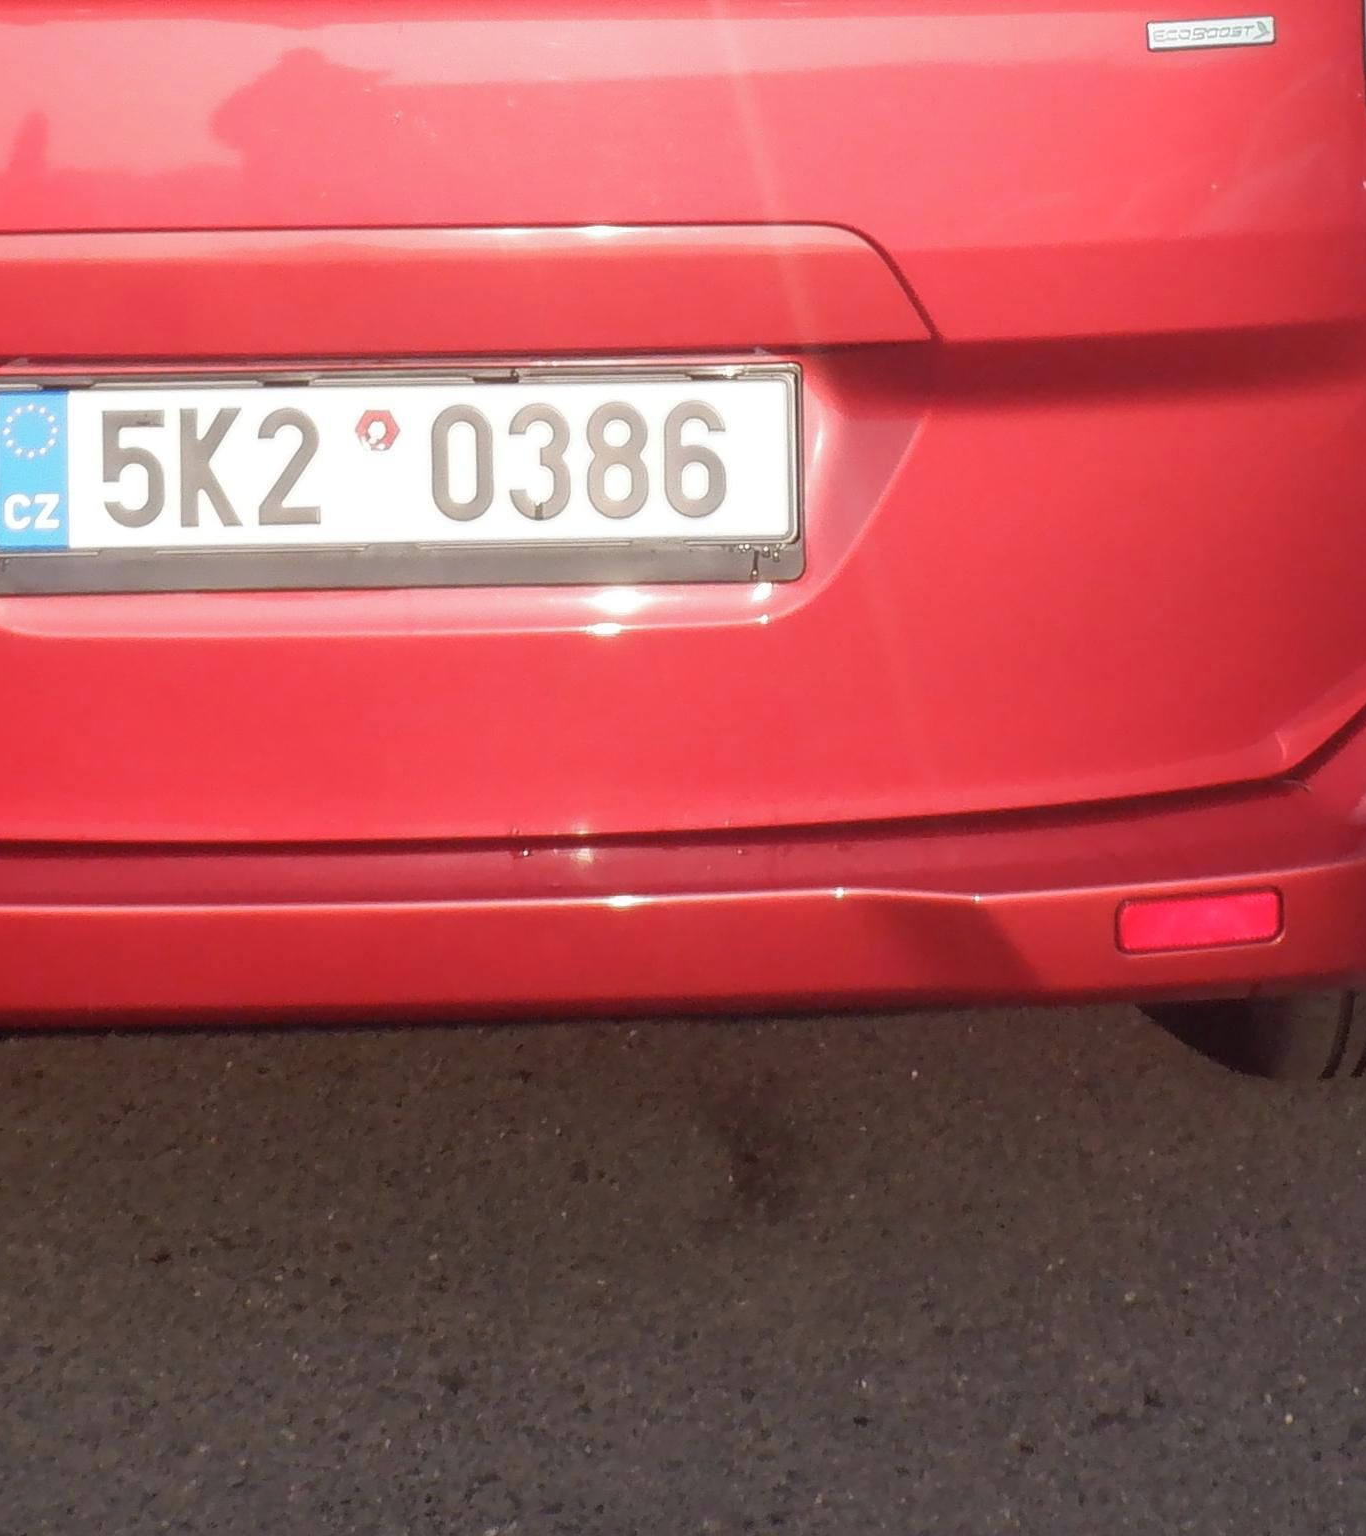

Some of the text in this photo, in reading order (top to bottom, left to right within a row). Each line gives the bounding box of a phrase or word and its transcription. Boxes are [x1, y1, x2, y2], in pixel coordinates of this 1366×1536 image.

[101, 400, 728, 529] 5K2 0386
[2, 493, 60, 531] CZ
